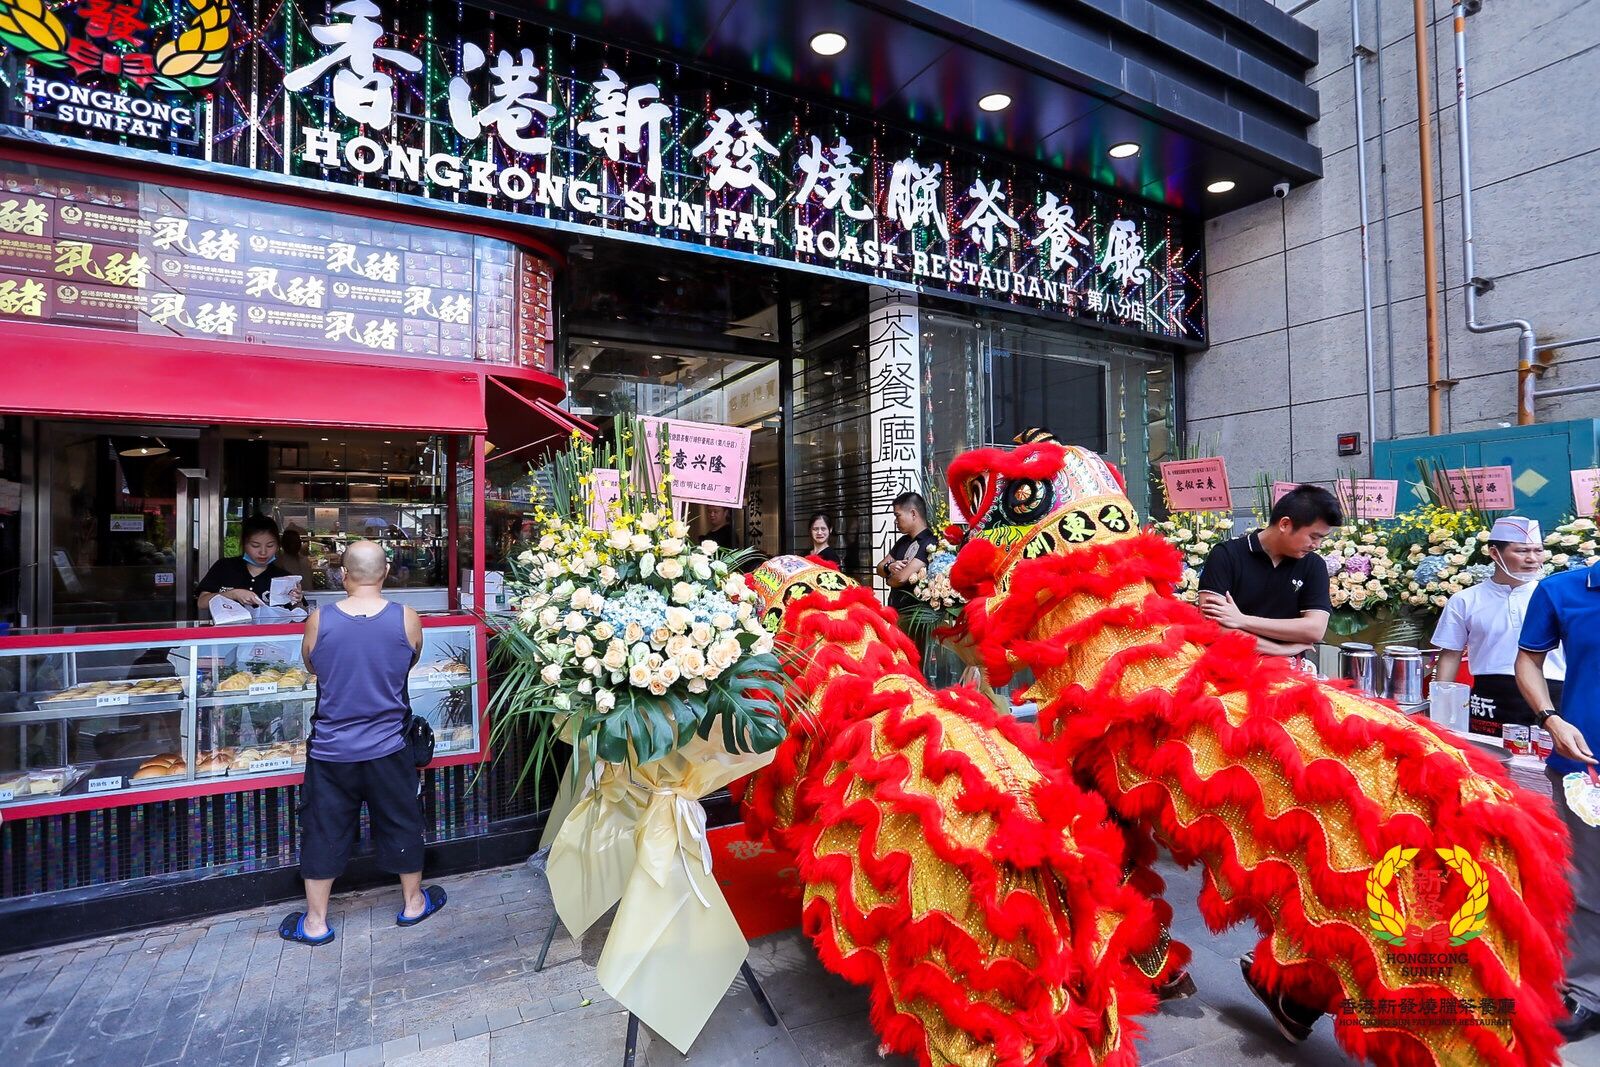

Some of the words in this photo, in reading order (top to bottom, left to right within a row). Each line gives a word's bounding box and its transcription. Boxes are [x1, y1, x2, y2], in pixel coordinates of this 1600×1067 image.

[24, 76, 193, 126] HONGKONG
[58, 105, 163, 139] SUNFAT
[301, 125, 598, 213] HONGKONG
[624, 190, 704, 232] SUN
[715, 207, 778, 245] FAT
[796, 223, 898, 270] ROAST
[913, 251, 1071, 306] RESTAURANT
[1087, 288, 1146, 324] 第八分店
[1470, 694, 1497, 719] 新
